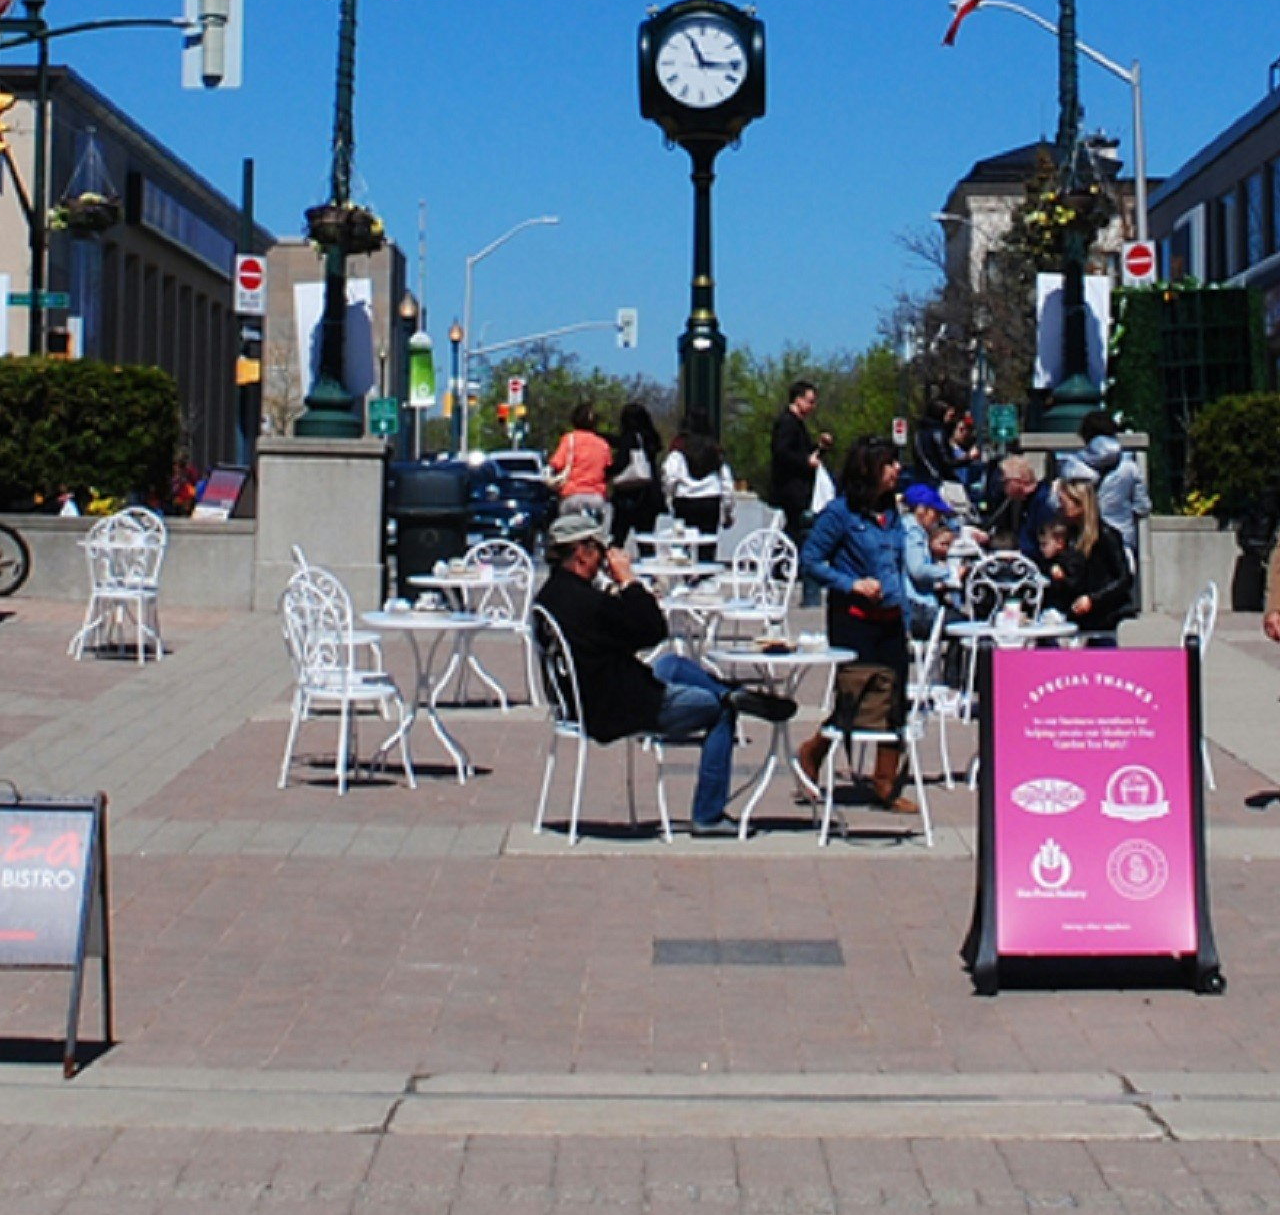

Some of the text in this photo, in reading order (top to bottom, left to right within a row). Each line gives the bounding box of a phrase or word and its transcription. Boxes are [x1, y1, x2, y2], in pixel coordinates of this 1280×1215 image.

[1028, 673, 1154, 703] SPECIAL THANKS
[1, 868, 76, 890] BISTRO
